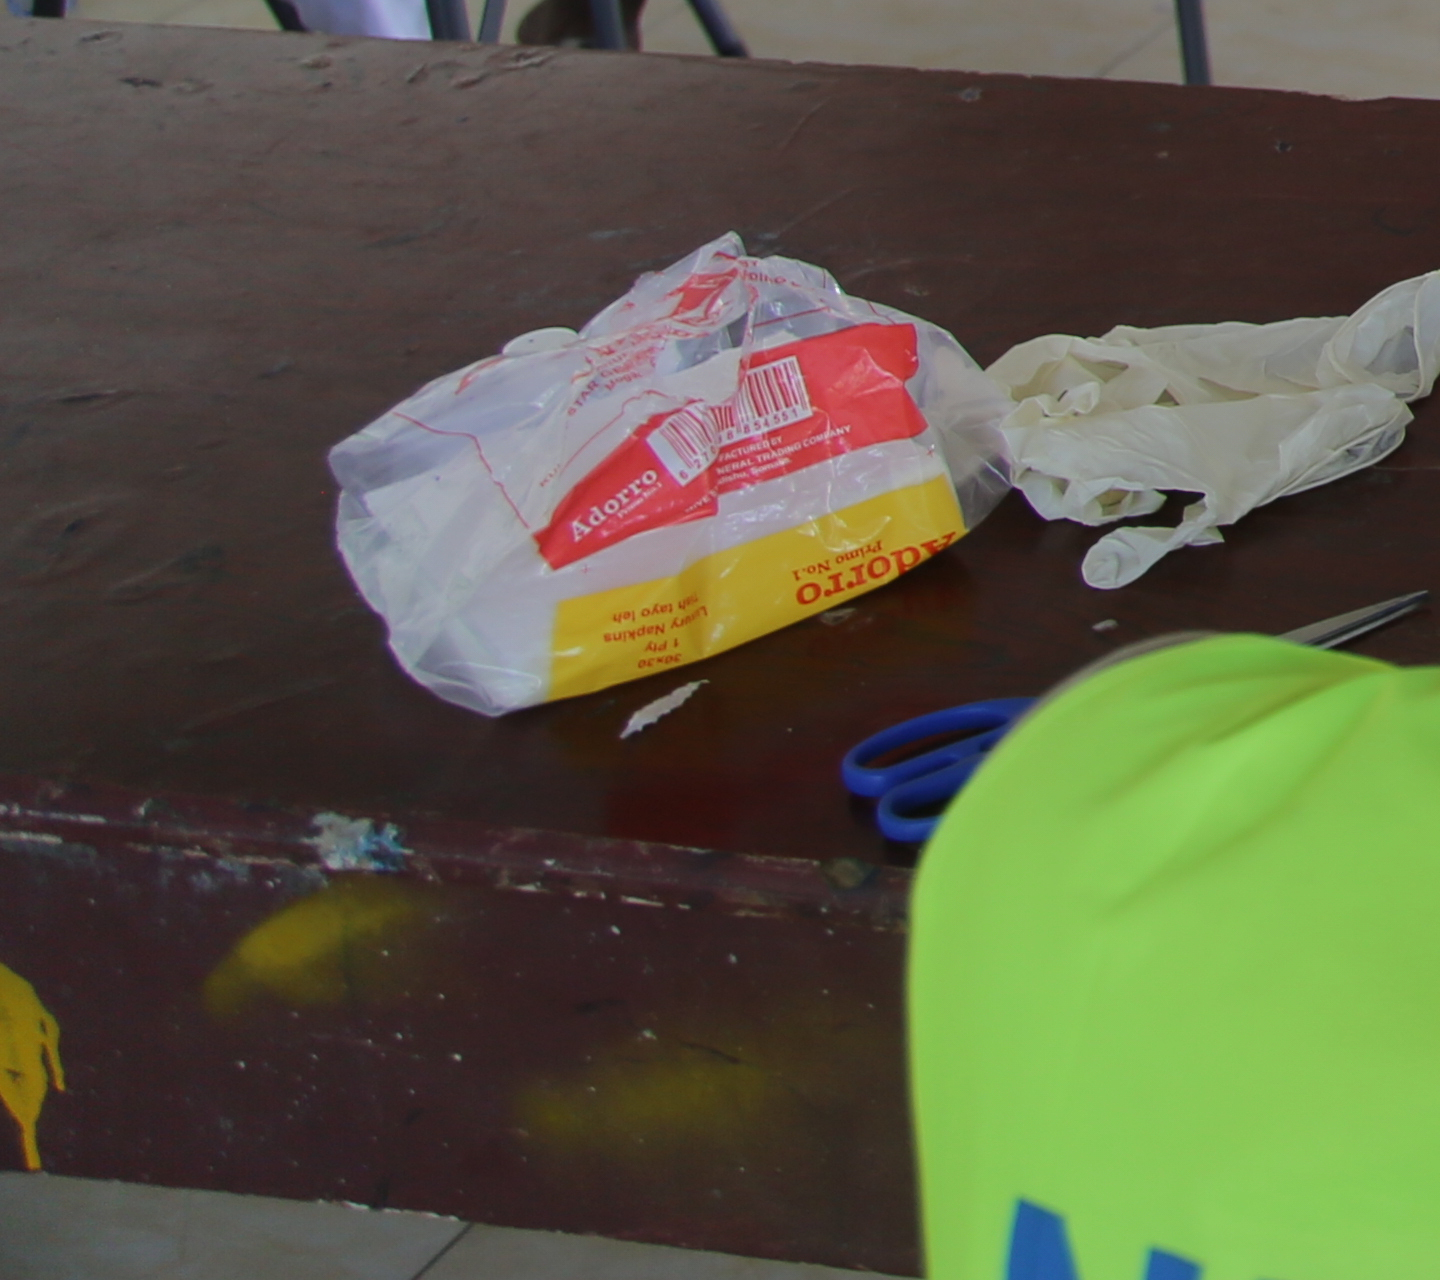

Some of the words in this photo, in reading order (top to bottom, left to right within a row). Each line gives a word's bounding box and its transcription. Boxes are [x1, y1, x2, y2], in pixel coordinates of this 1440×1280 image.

[755, 444, 801, 463] TRADING
[802, 425, 852, 448] COMPANY
[570, 469, 658, 542] Adorro
[835, 540, 883, 565] Primo
[792, 559, 830, 582] No.1
[796, 531, 957, 605] Adorro
[613, 611, 635, 624] leh
[641, 603, 673, 617] tayo
[603, 623, 665, 642] Napkins
[645, 640, 668, 652] Ply
[673, 638, 679, 648] 1
[638, 653, 682, 669] 30x30
